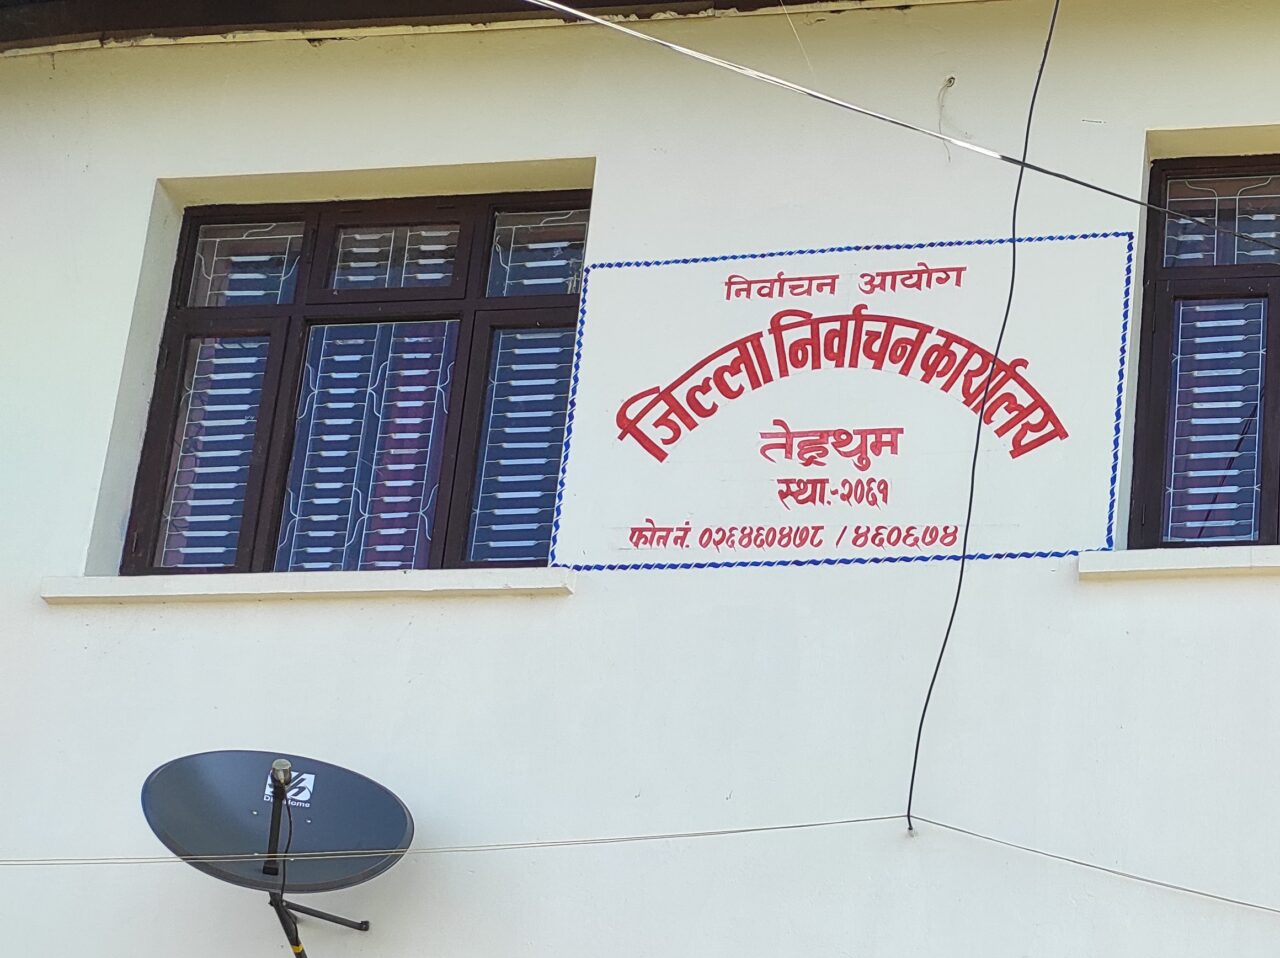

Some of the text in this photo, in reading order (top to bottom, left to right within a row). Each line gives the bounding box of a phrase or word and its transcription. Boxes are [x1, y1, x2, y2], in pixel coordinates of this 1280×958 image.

[725, 261, 967, 300] निर्वाचन आयोग
[615, 303, 1070, 463] जिल्ला निर्वाचन कार्यालय
[698, 525, 824, 553] ०२६४६०४७८
